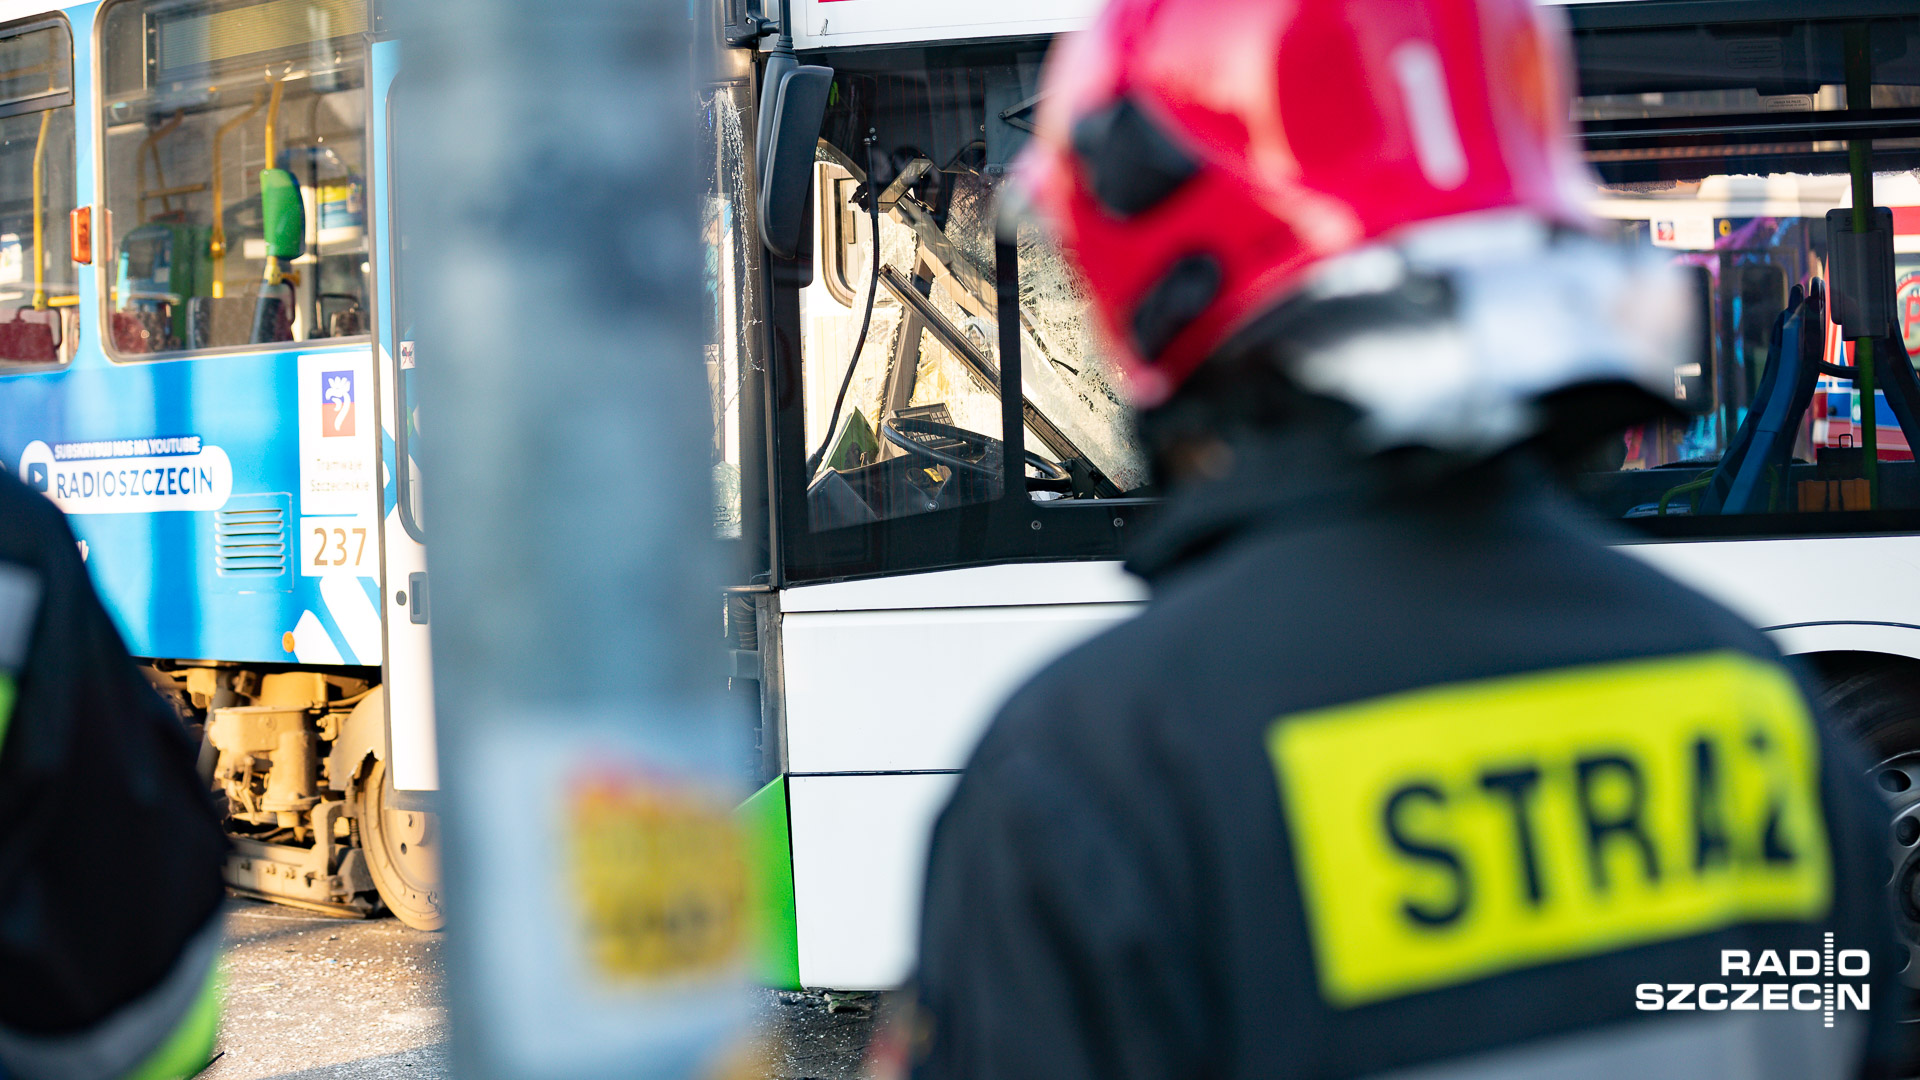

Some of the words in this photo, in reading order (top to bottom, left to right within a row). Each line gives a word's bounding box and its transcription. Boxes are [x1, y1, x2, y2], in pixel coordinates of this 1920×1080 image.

[149, 436, 200, 454] YOUTUBE
[57, 467, 212, 498] RADIOSZCZECIN
[314, 528, 366, 566] 237
